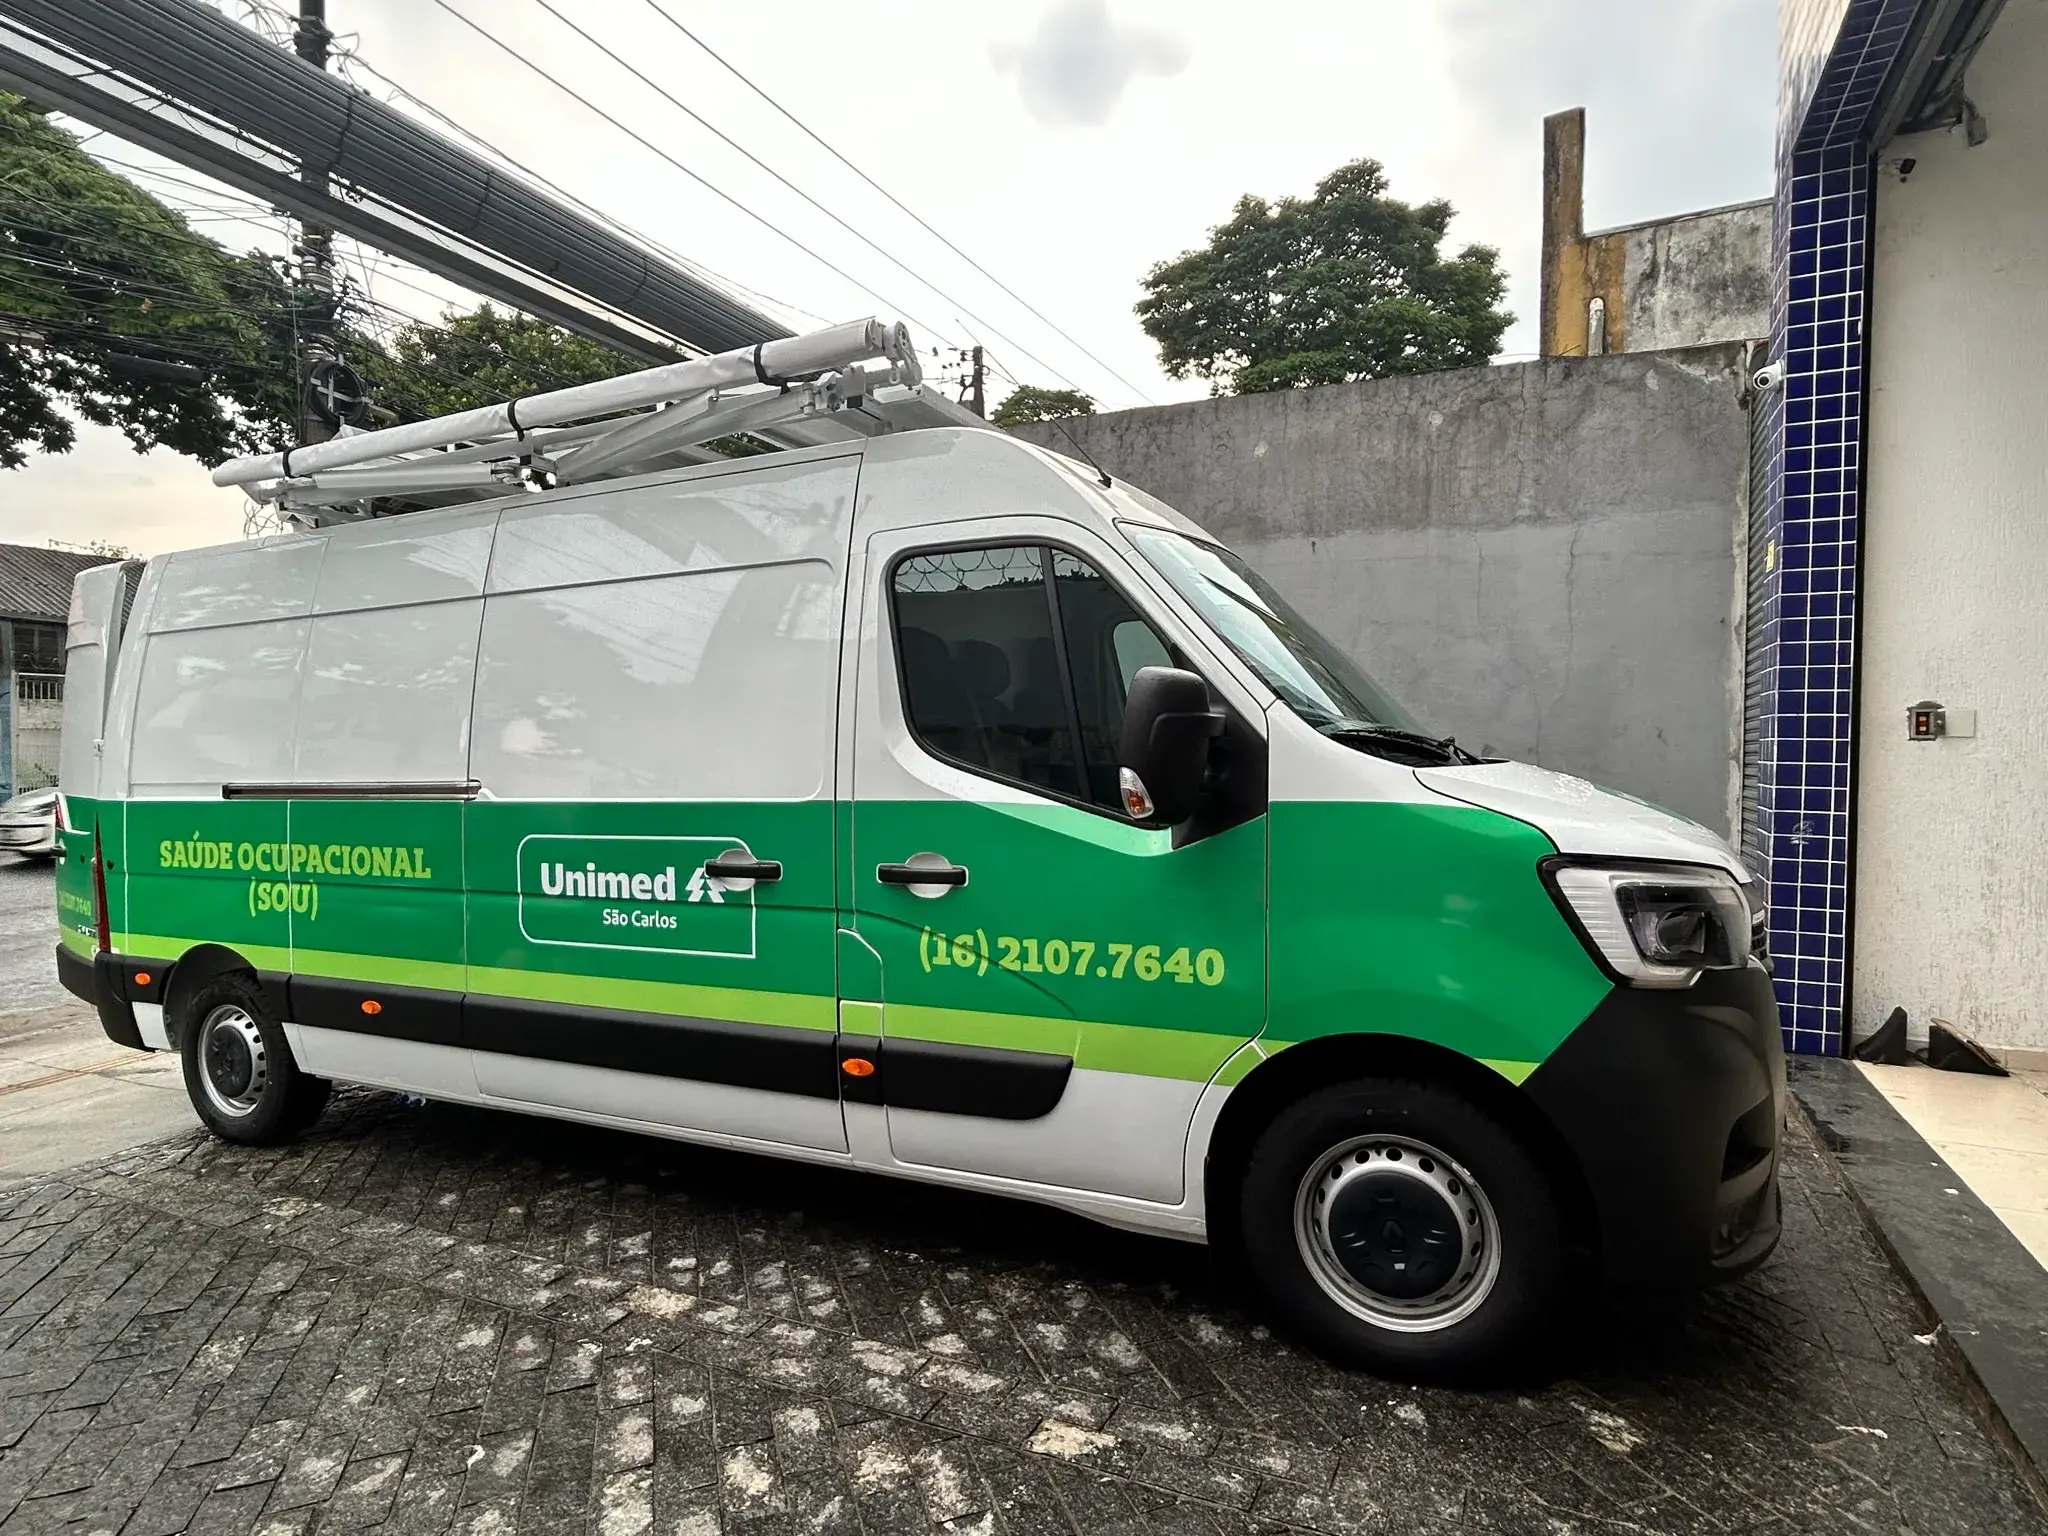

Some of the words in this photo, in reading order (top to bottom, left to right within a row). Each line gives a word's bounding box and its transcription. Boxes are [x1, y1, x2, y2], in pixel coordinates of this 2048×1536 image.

[159, 830, 233, 870] SAÚDE
[237, 842, 432, 879] OCUPACIONAL
[248, 876, 318, 921] (SOU)
[540, 862, 676, 901] Unimed
[602, 908, 629, 926] São
[631, 910, 678, 929] Carlos
[919, 925, 990, 977] (16)
[997, 936, 1226, 986] 2107.7640
